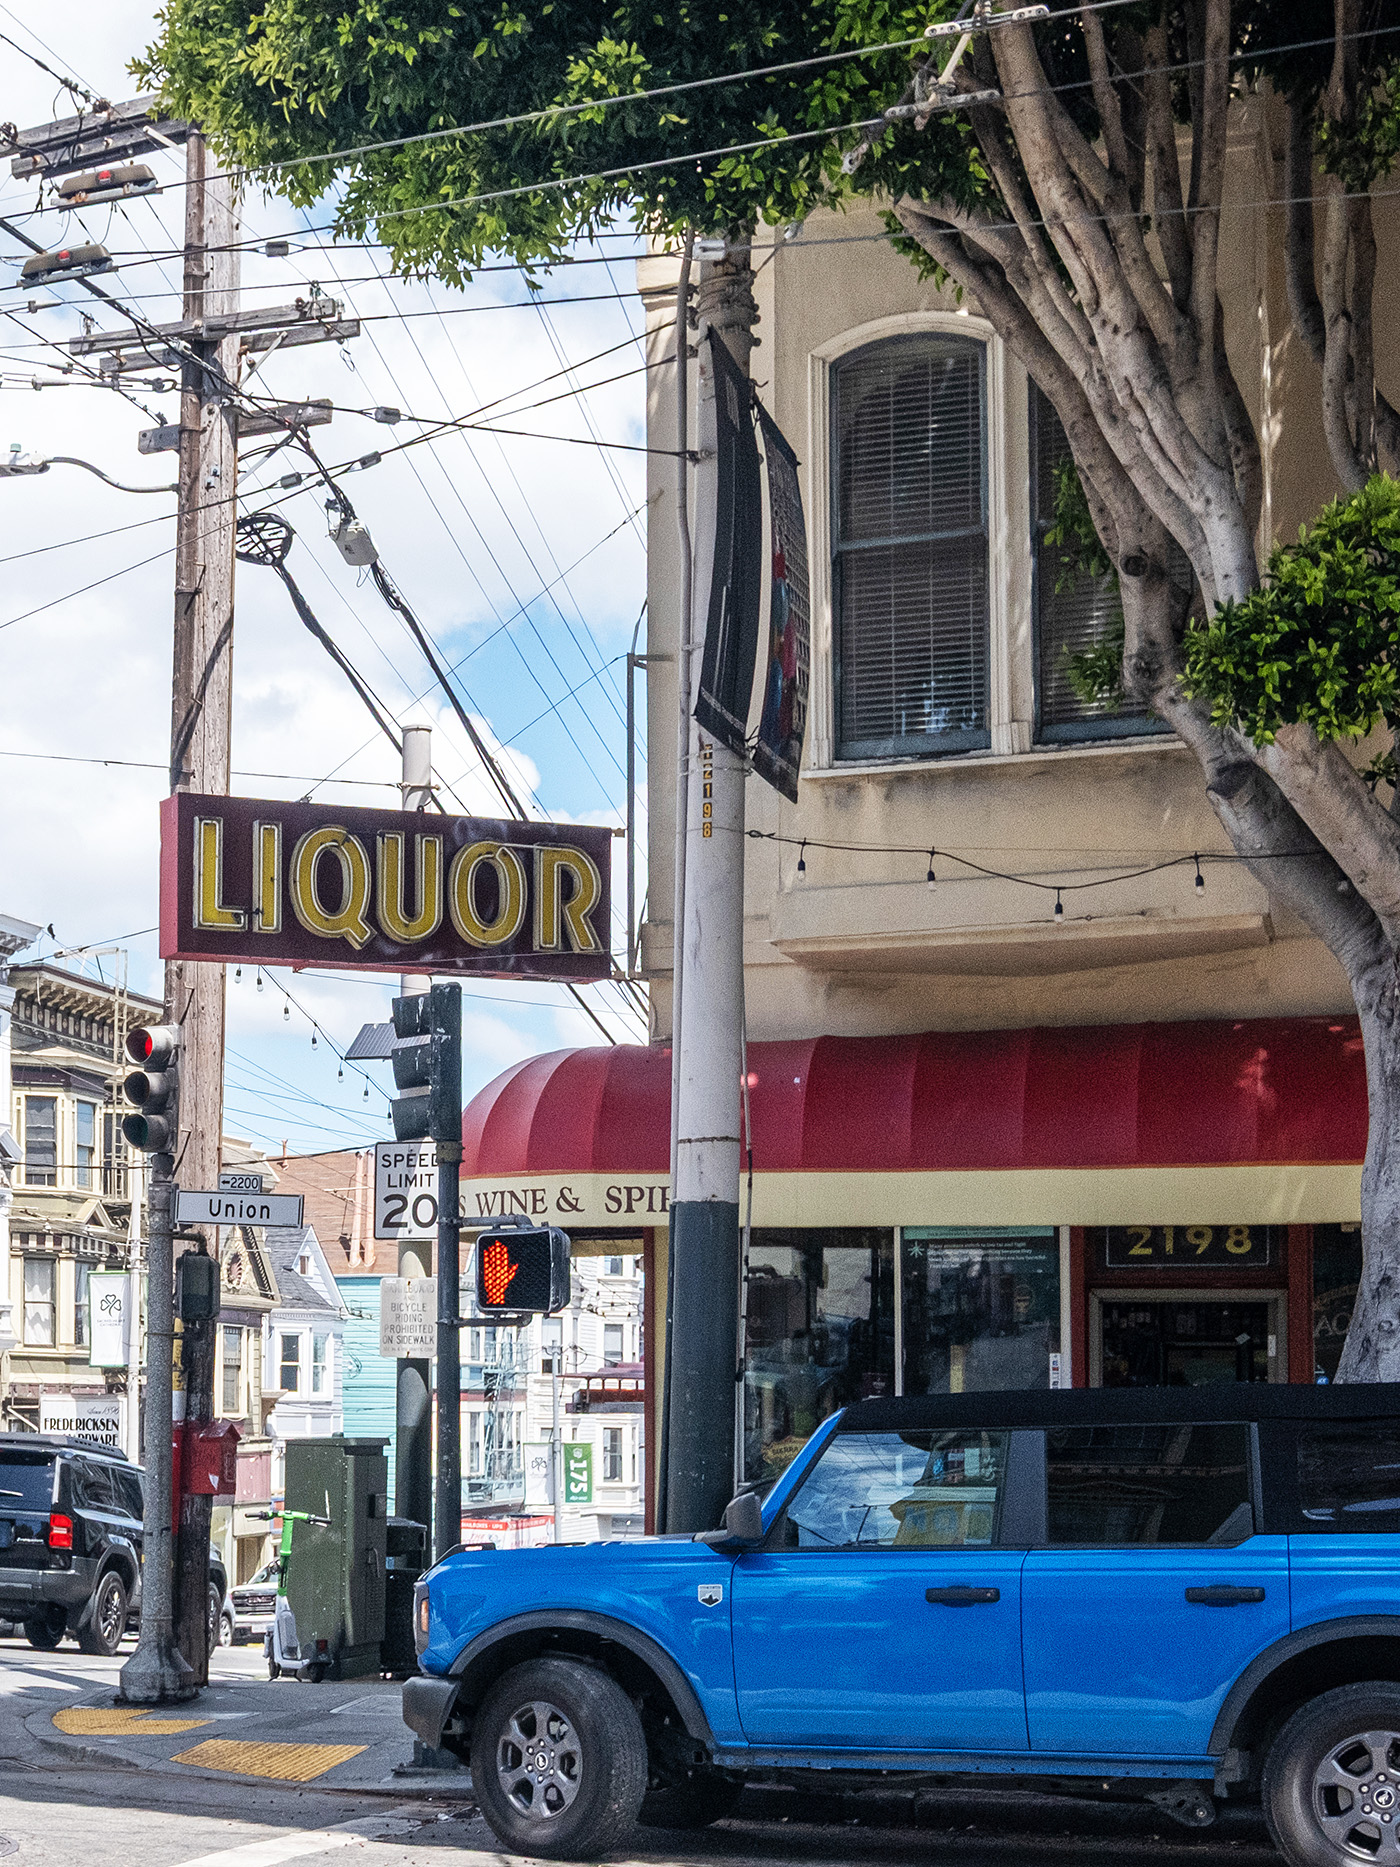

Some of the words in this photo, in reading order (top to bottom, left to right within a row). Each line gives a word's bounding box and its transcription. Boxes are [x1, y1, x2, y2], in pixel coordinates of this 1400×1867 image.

[193, 816, 604, 954] LIQUOR
[230, 1177, 258, 1189] 2200
[388, 1174, 434, 1188] LIMIT
[476, 1188, 549, 1217] WINE
[556, 1186, 585, 1213] &
[209, 1199, 270, 1219] Union
[382, 1194, 438, 1228] 20
[1126, 1225, 1252, 1255] 2198
[391, 1303, 427, 1312] BICYCLE
[395, 1314, 423, 1323] RIDING
[384, 1324, 434, 1334] PROHIBITED
[383, 1335, 393, 1344] ON
[396, 1335, 435, 1345] SIDEWALK
[44, 1417, 119, 1431] FREDERICKSEN
[570, 1460, 587, 1493] 175
